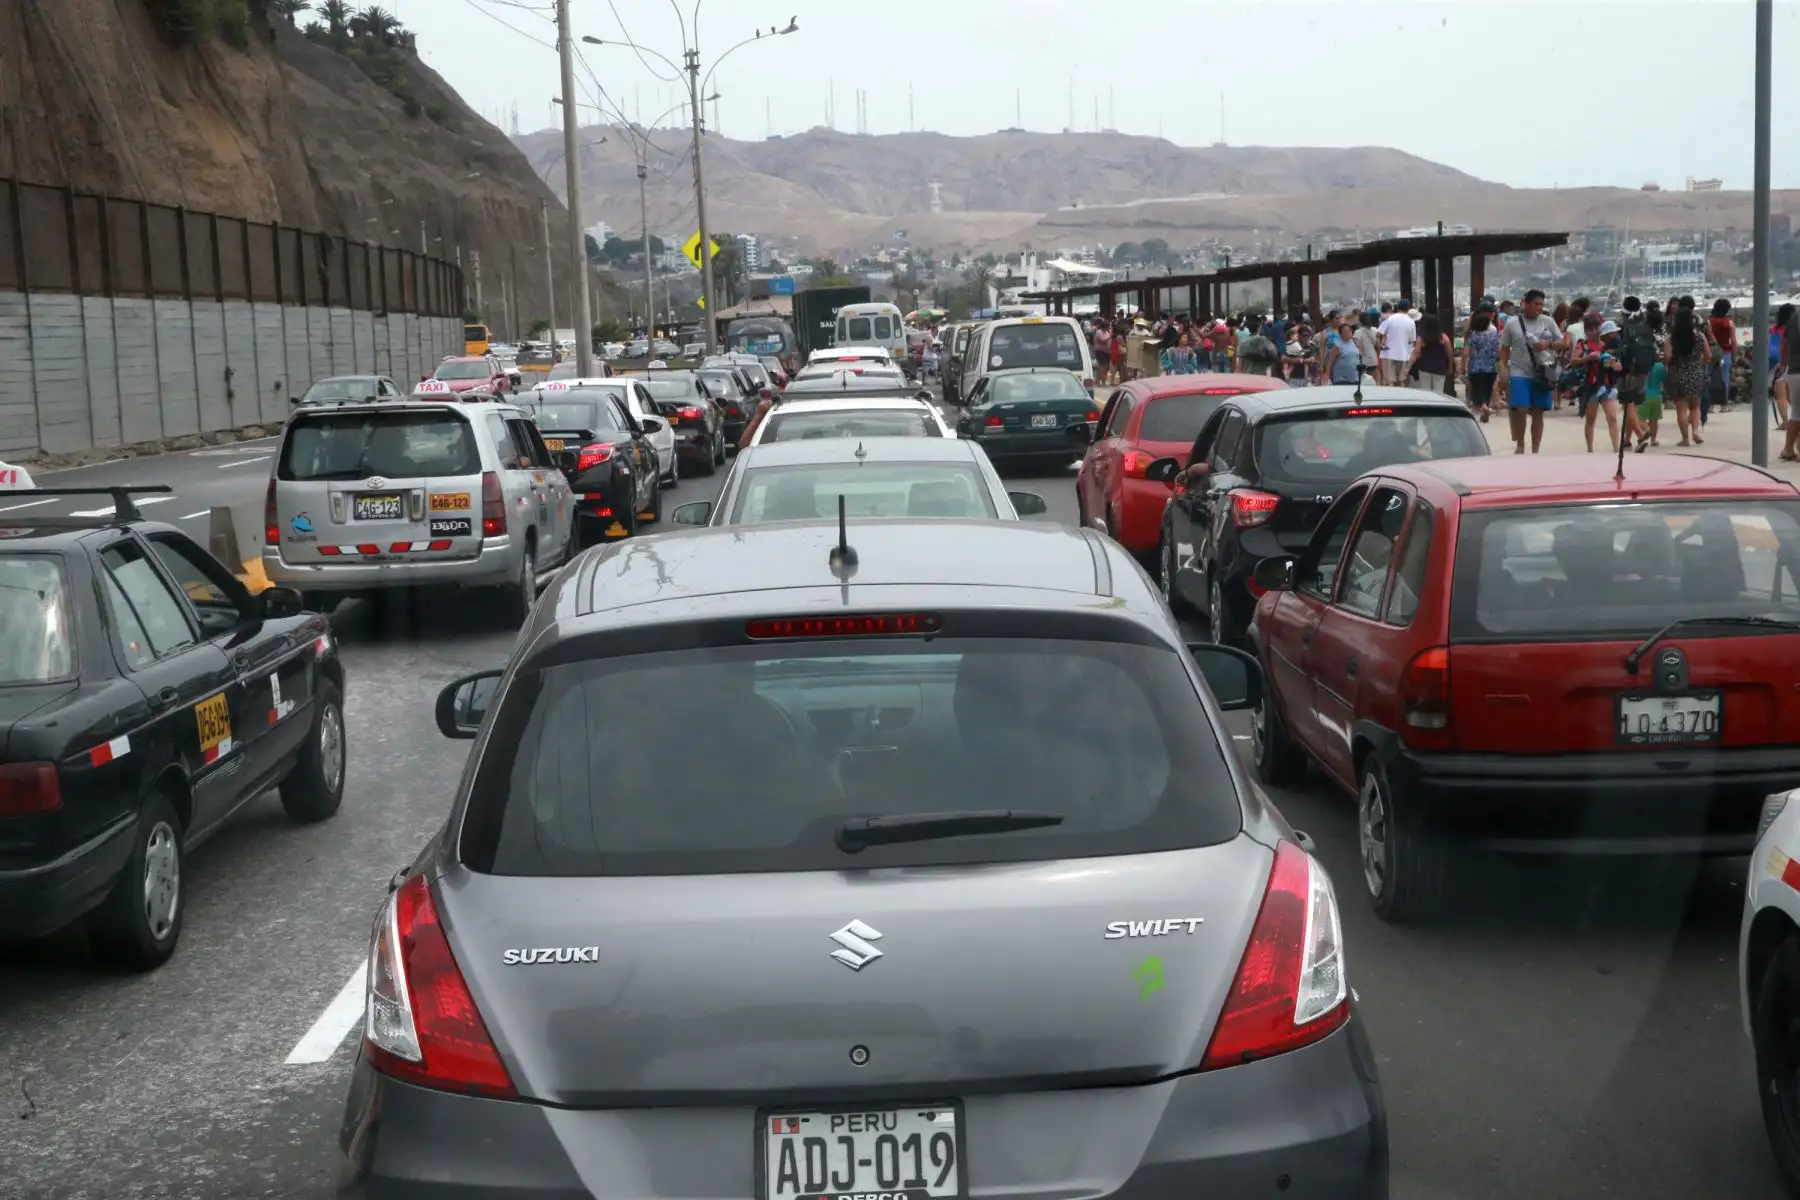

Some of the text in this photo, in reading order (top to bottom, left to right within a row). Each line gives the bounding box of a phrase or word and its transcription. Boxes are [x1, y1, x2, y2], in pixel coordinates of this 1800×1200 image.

[420, 384, 443, 392] TAXI
[1104, 917, 1204, 939] SWIFT
[503, 946, 600, 965] SUZUKI
[830, 1112, 898, 1133] PERU
[777, 1132, 954, 1195] ADJ-019
